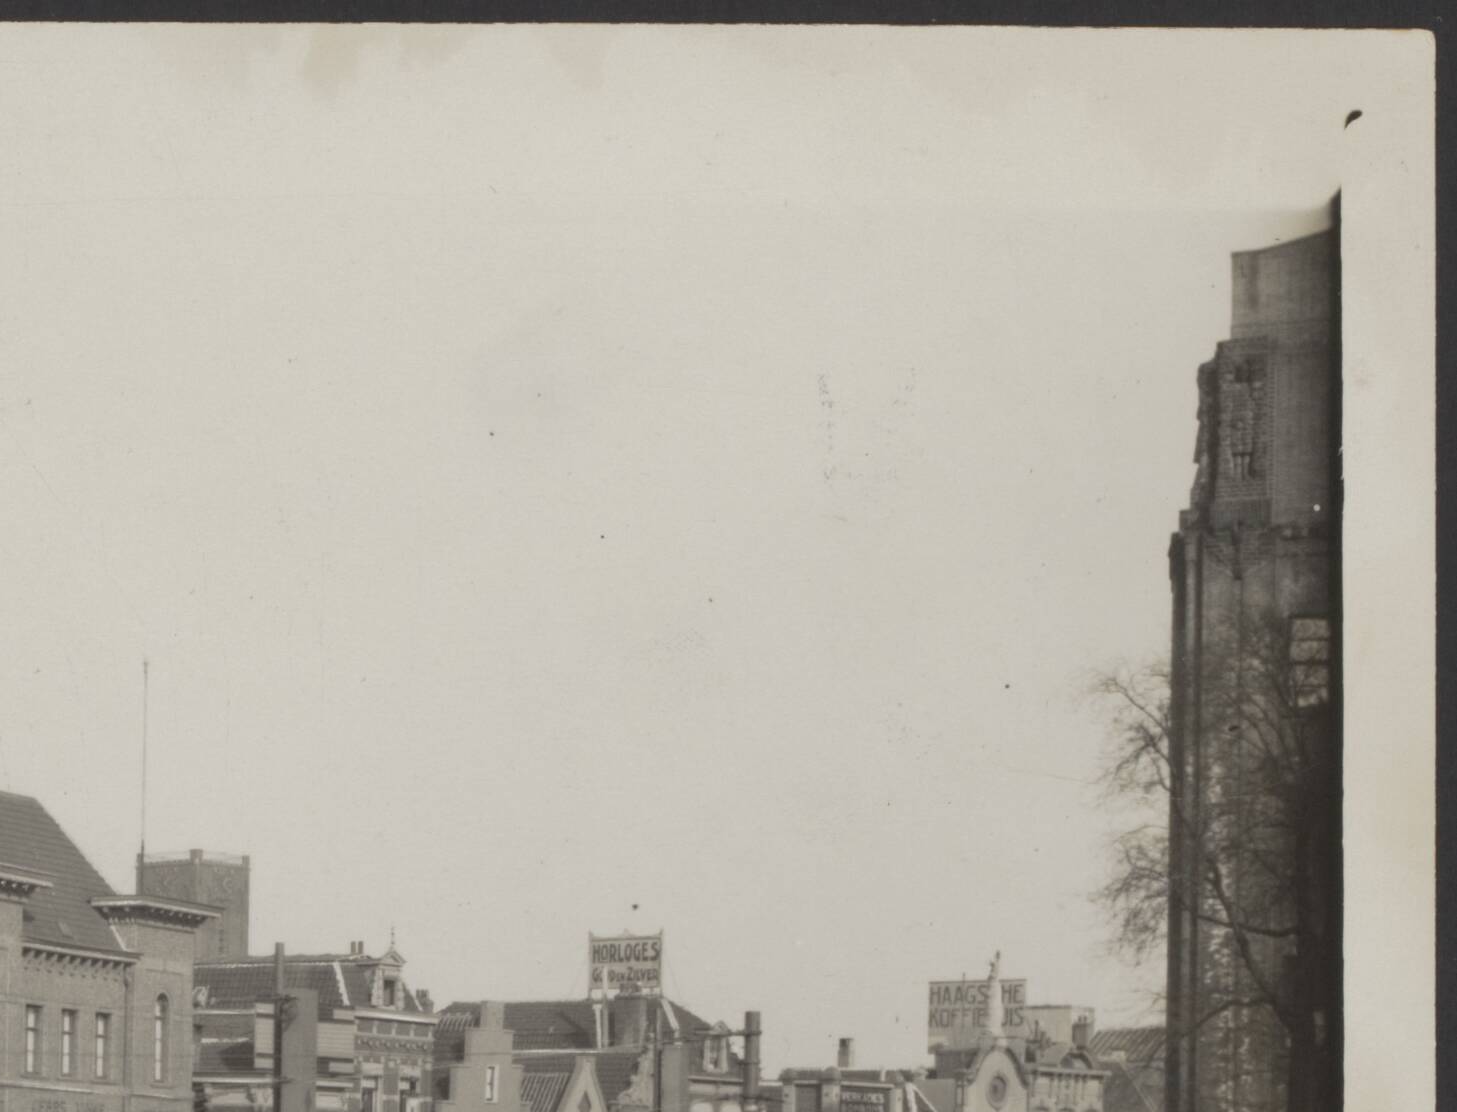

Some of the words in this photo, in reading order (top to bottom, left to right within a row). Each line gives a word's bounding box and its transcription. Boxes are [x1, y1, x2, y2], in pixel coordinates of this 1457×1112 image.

[592, 942, 659, 963] HORLOGES
[929, 984, 1025, 1006] HAAGSHE
[929, 1006, 1025, 1028] KOFFIEIS
